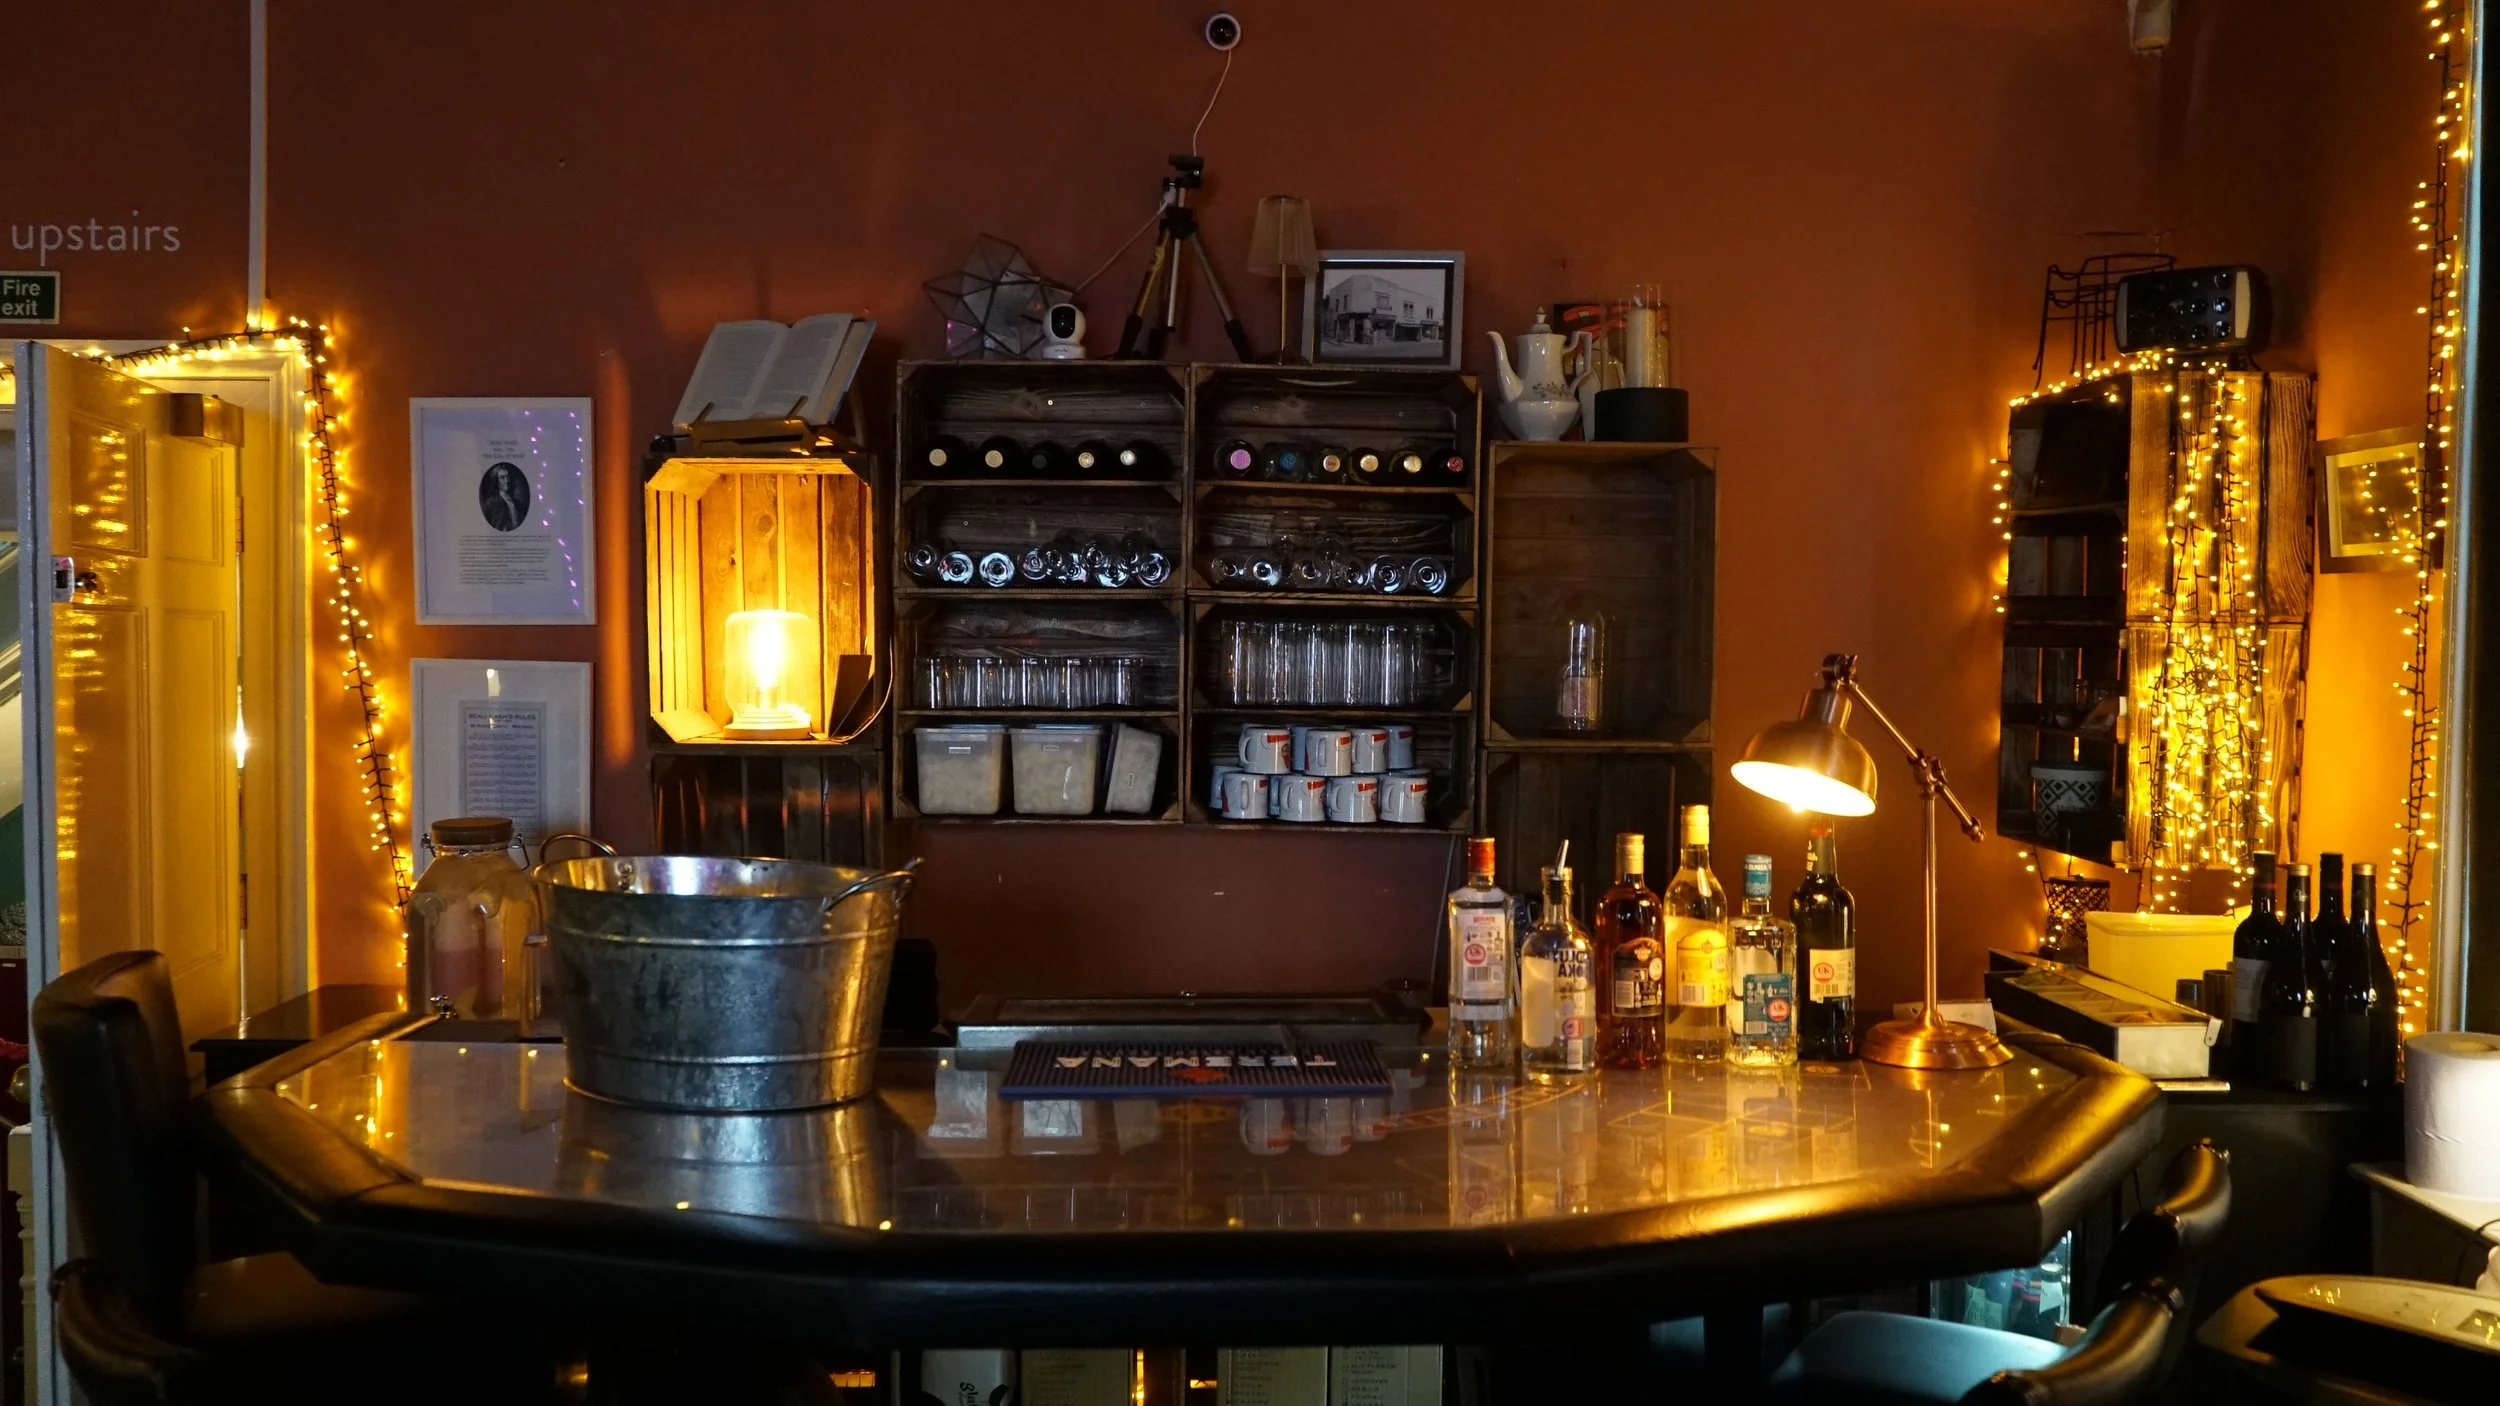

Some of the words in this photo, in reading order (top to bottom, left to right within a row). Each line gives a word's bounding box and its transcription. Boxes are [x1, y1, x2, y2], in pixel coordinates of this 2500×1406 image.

[11, 209, 181, 267] upstairs
[2, 279, 41, 296] Fire
[1, 299, 38, 316] exit
